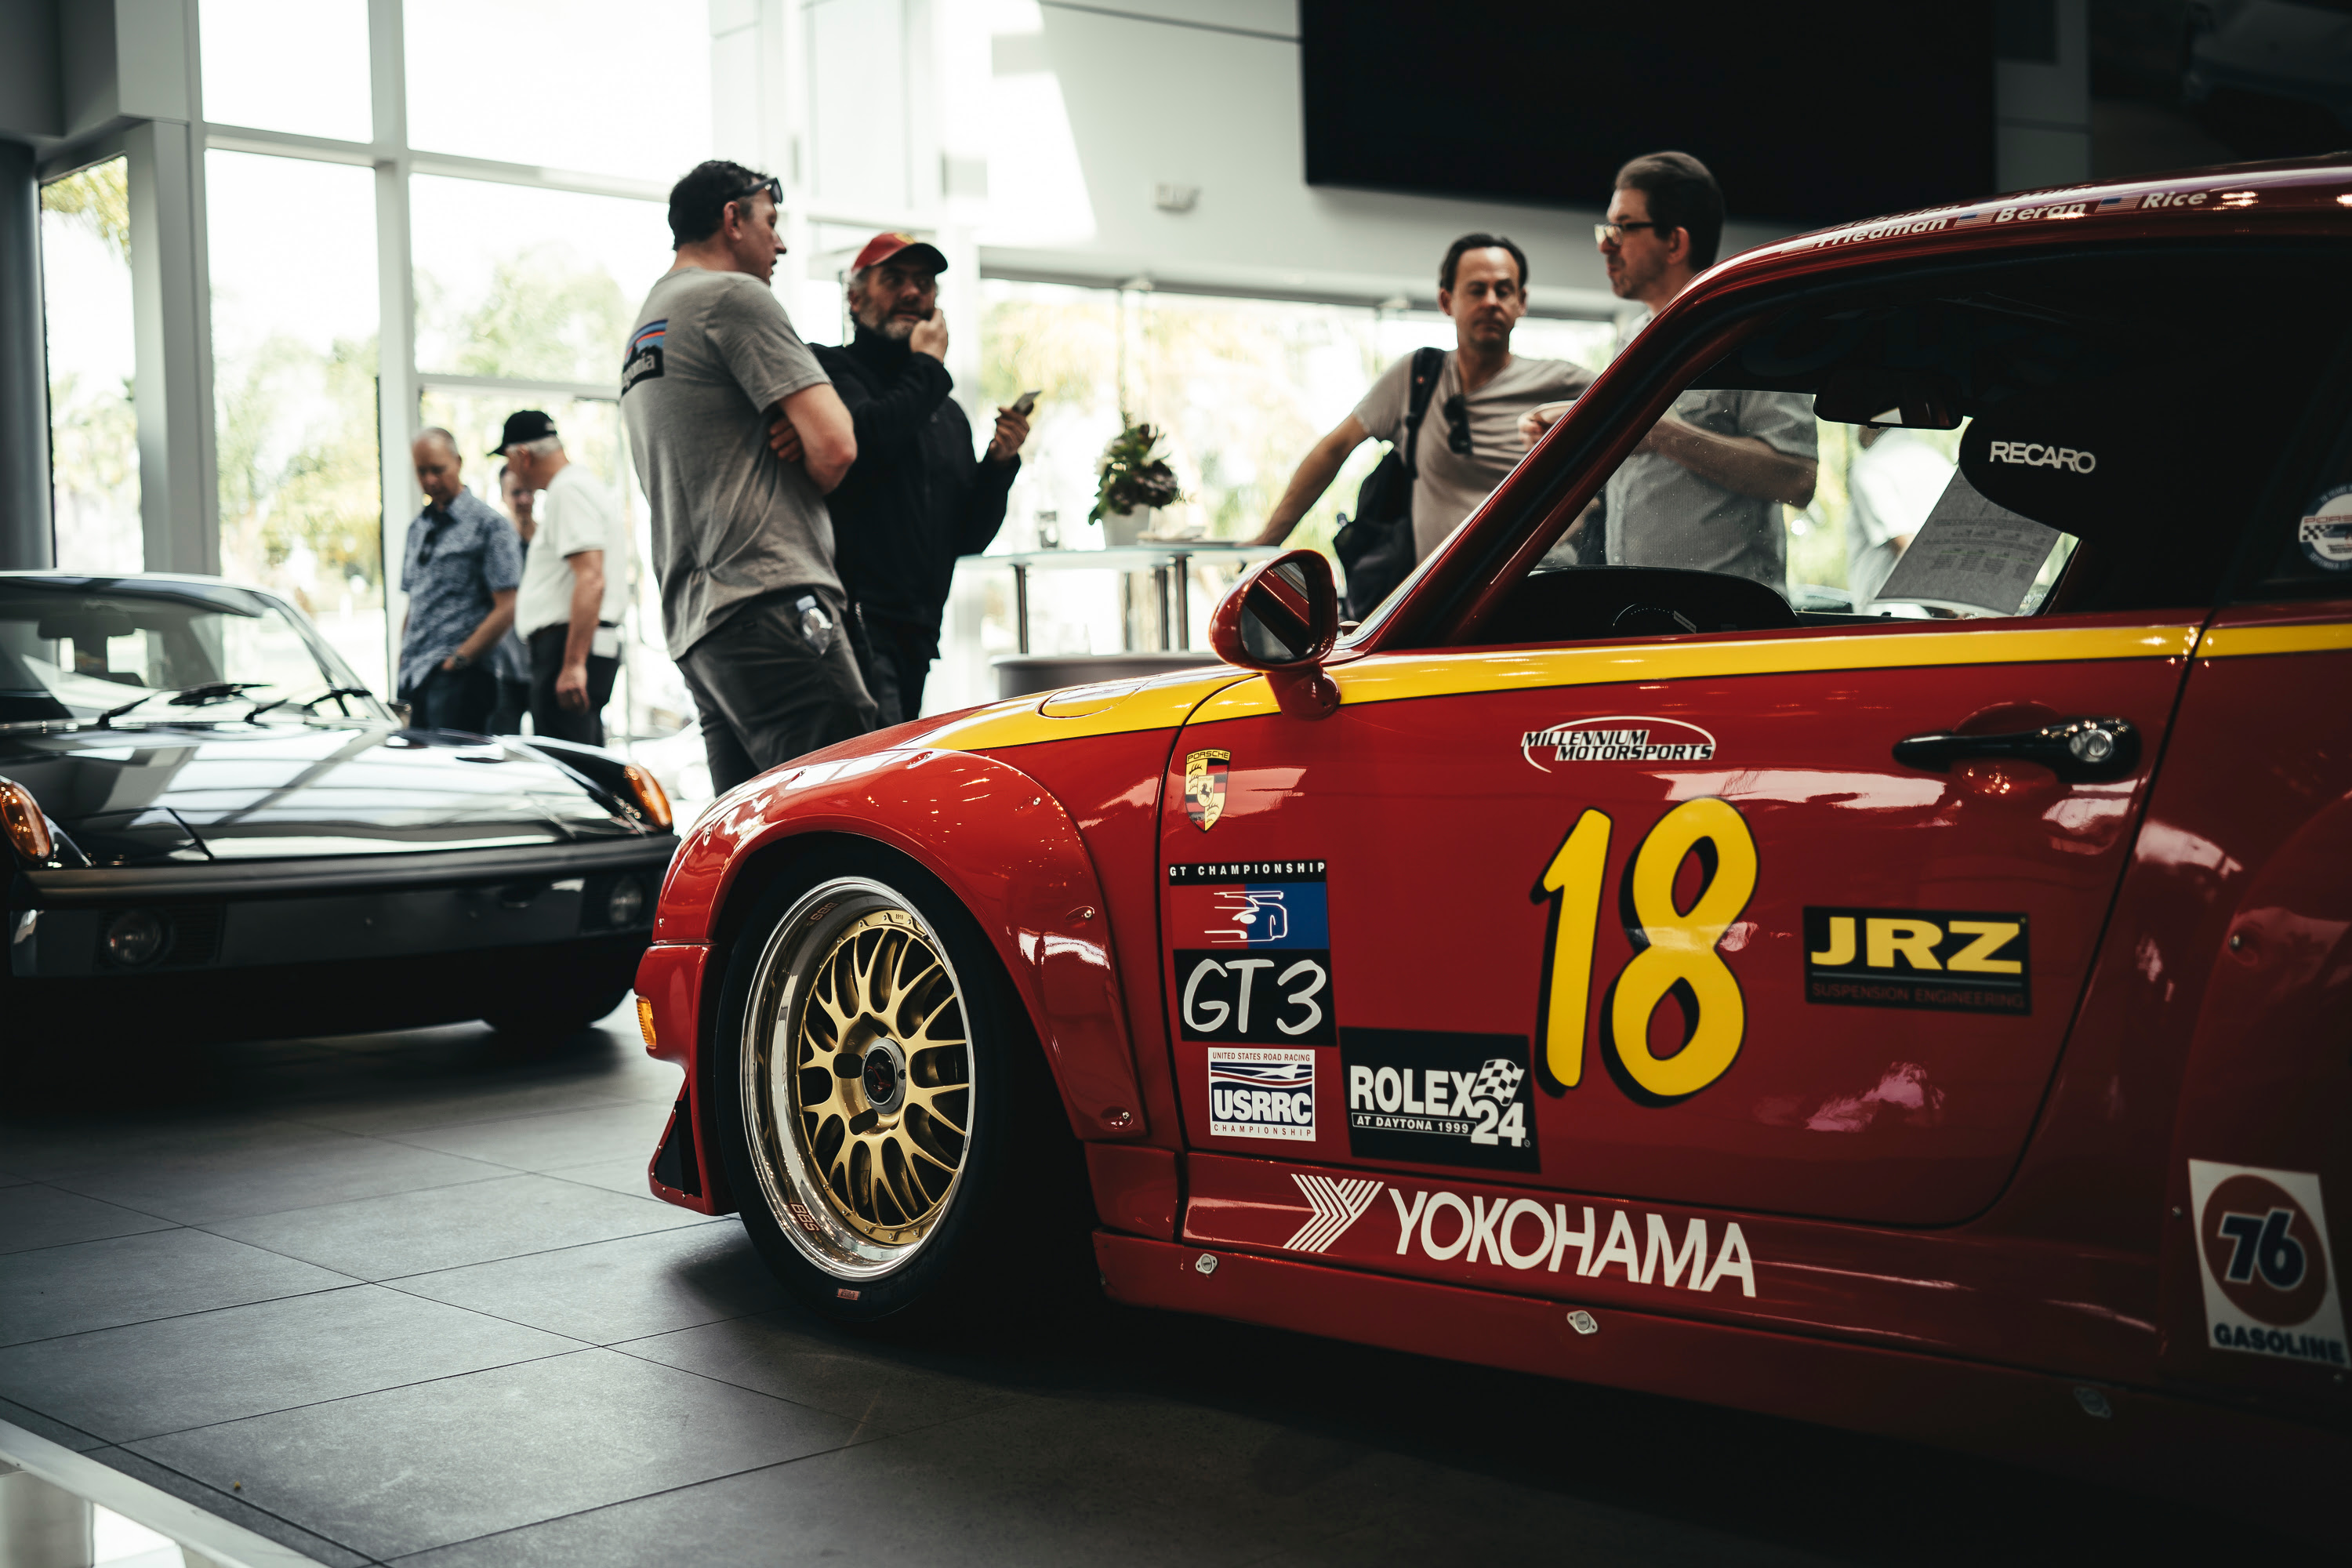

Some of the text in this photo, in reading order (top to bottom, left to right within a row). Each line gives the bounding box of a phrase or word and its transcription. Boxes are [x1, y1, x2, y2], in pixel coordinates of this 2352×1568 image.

[1816, 191, 2208, 248] Friedman Beran Rice
[1989, 441, 2096, 474] RECARO
[1525, 730, 1648, 746] MILLENNIUM
[1557, 744, 1713, 760] MOTORSPORTS
[1187, 750, 1229, 762] PORSCHE
[1169, 862, 1326, 877] GT CHAMPIONSHIP
[1534, 797, 1759, 1106] 18
[1810, 916, 2022, 974] JRZ
[1812, 982, 2025, 1009] SUSPENSION ENGINEERING
[1212, 1051, 1236, 1060] UNITED
[1237, 1052, 1261, 1061] STATES
[1213, 1089, 1312, 1124] USRRC
[1350, 1065, 1481, 1119] ROLEX
[1214, 1123, 1312, 1137] CHAMPIONSHIP
[1356, 1115, 1469, 1134] AT DAYTONA 1999
[1471, 1099, 1527, 1148] 24
[790, 1203, 820, 1232] BBS
[1388, 1188, 1757, 1298] YOKOHAMA
[2218, 1208, 2306, 1291] 76
[2213, 1323, 2346, 1365] GASOLINE
